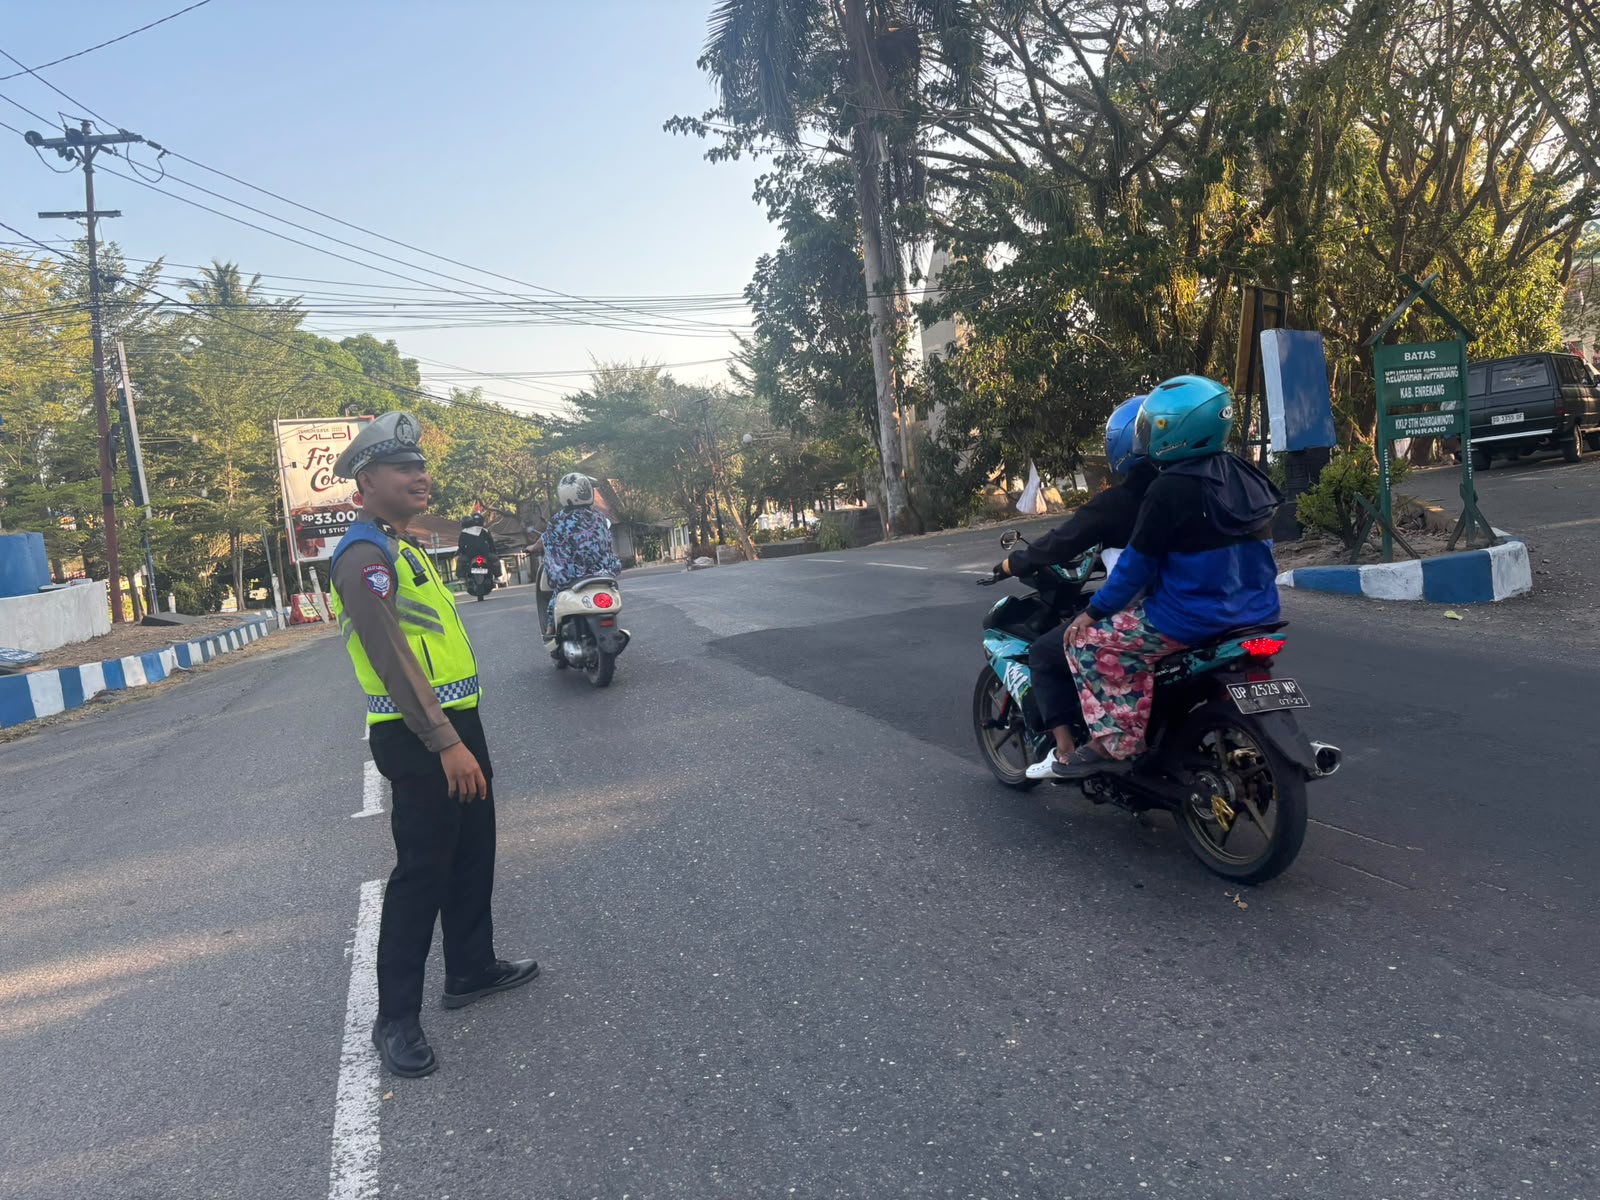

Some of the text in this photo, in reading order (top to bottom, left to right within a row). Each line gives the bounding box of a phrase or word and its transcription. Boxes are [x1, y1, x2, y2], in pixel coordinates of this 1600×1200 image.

[1404, 350, 1437, 361] BATAS
[1400, 384, 1445, 399] KAB. ENREKANG
[1405, 426, 1447, 436] PINRANG
[301, 510, 358, 525] Rp33.00
[1231, 681, 1296, 699] DP 2529 NP
